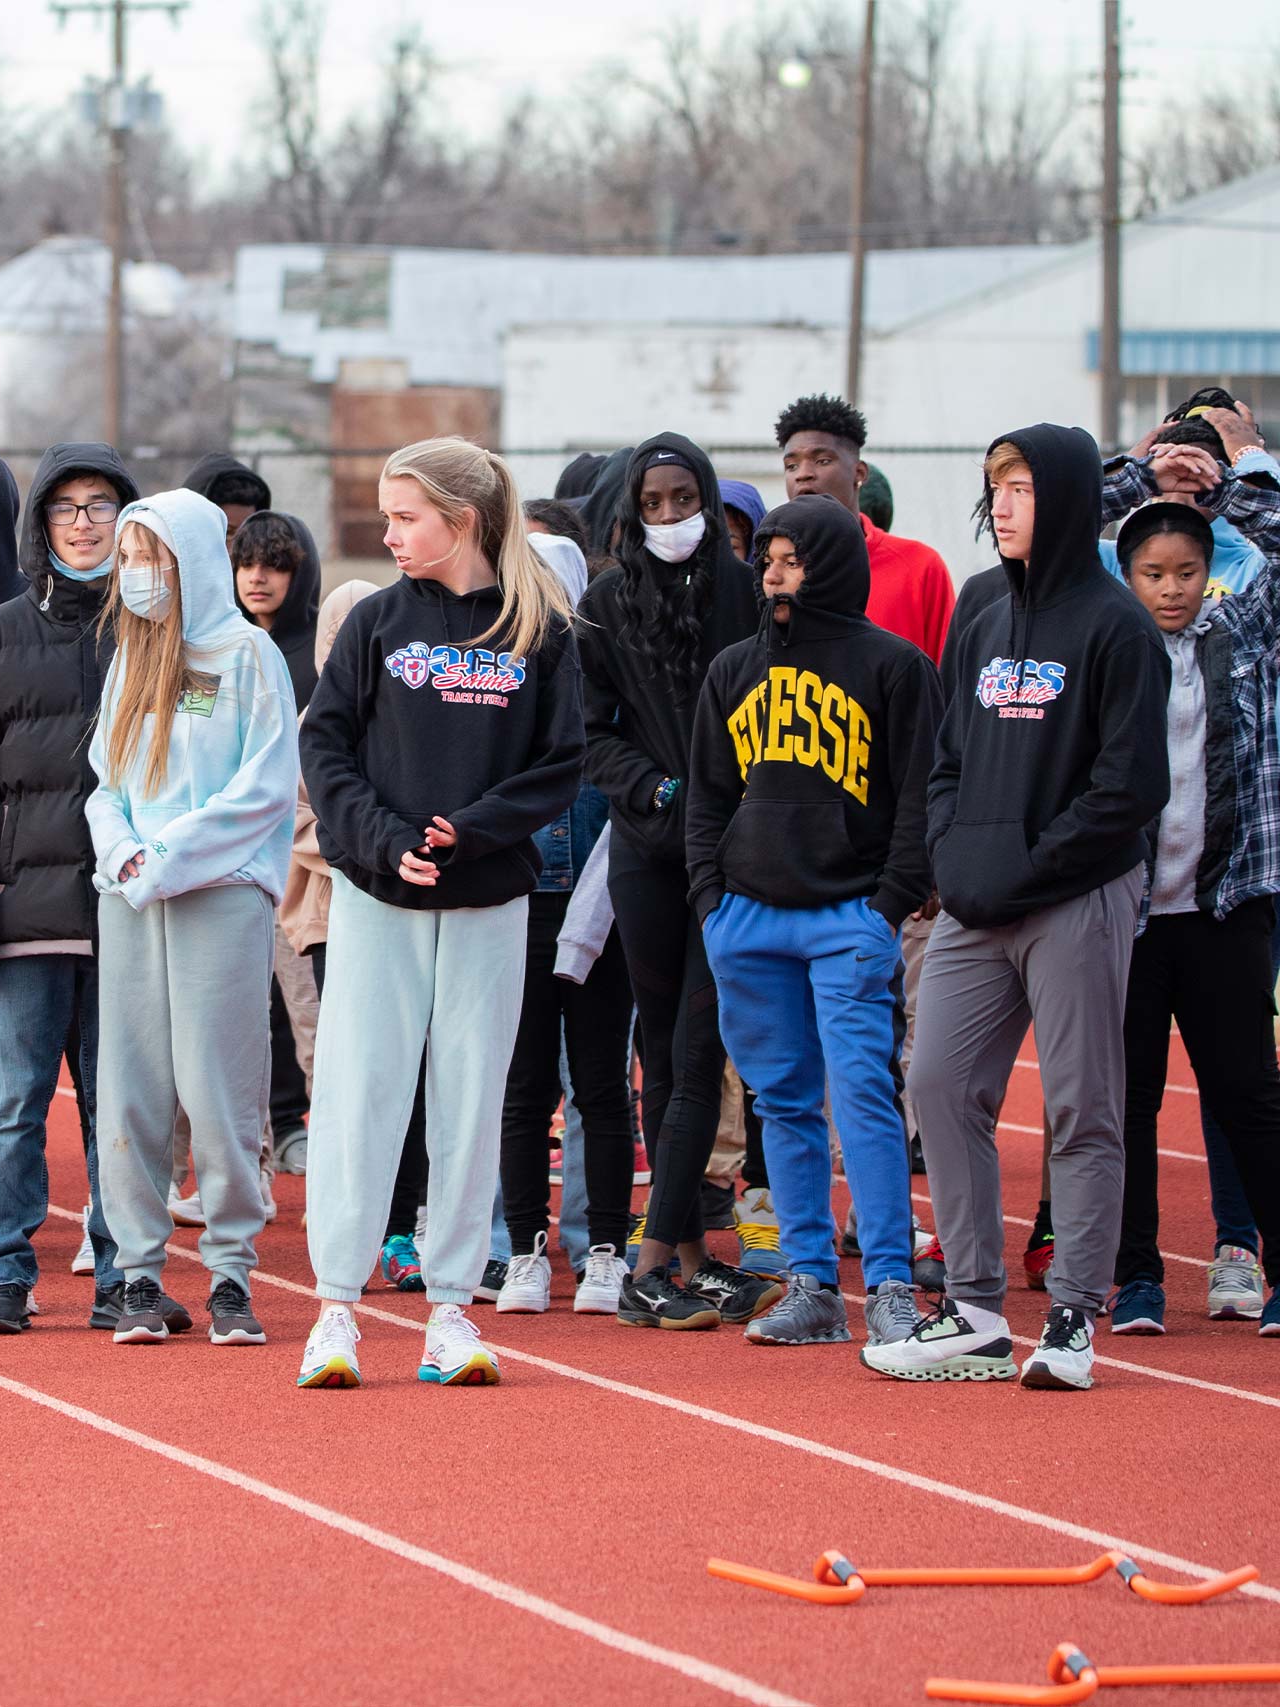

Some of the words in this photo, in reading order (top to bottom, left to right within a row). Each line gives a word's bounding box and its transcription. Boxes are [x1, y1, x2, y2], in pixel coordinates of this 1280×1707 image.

[430, 645, 526, 685] OCS
[432, 663, 520, 692] Saints
[441, 691, 474, 704] TRACK
[483, 693, 509, 708] FIELD
